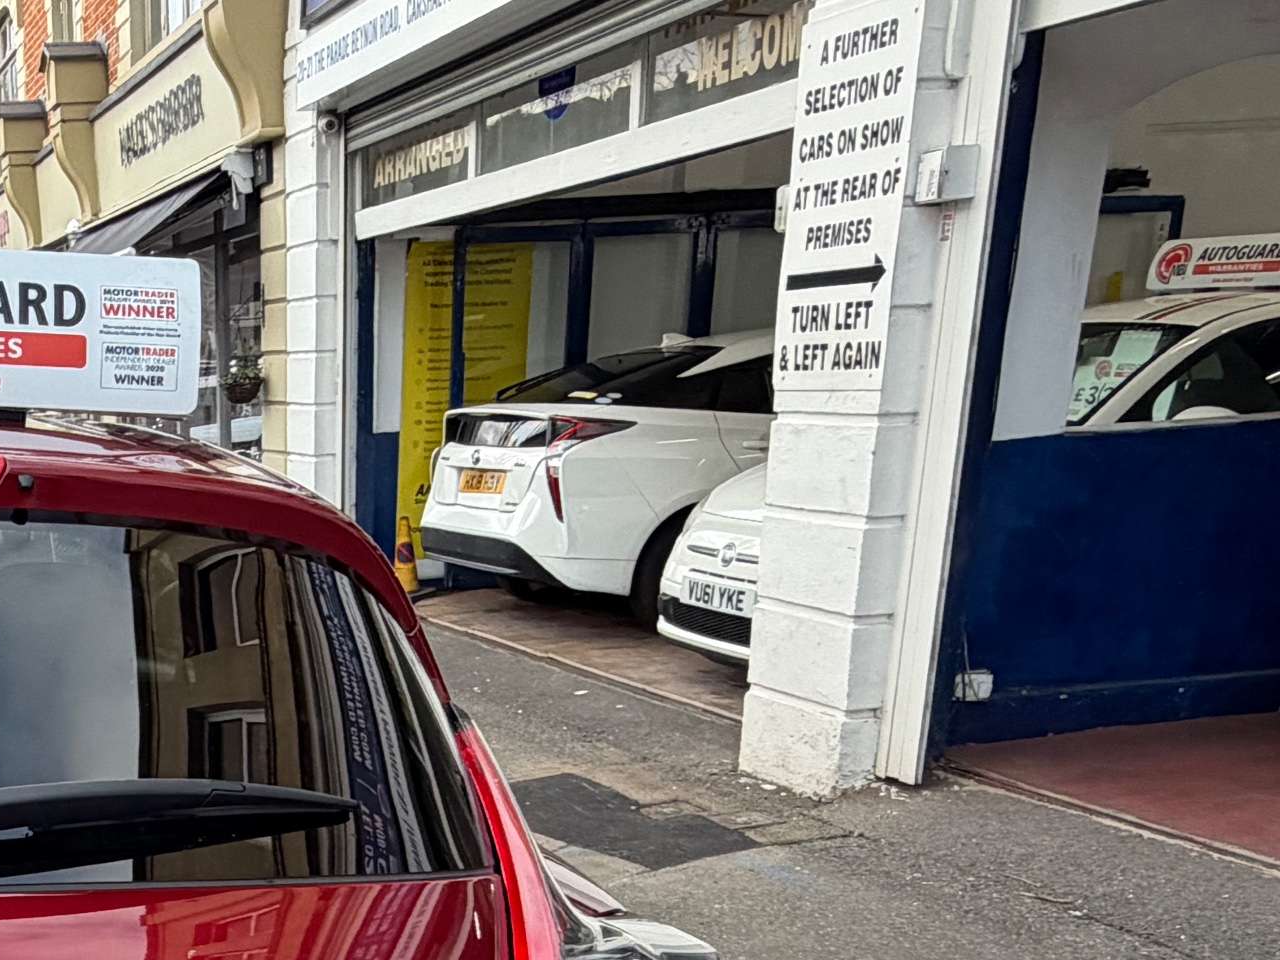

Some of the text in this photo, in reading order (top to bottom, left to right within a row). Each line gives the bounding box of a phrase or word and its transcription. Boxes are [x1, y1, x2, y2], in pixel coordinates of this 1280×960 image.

[697, 9, 804, 92] WELCOM
[820, 18, 899, 66] A FURTHER
[804, 66, 904, 116] SELECTION OF
[799, 115, 904, 163] CARS ON SHOW
[793, 185, 810, 212] AT
[814, 180, 838, 208] THE
[841, 172, 877, 203] REAR
[881, 167, 901, 196] OF
[805, 217, 872, 251] PREMISES
[1197, 243, 1280, 262] AUTOGUAR
[103, 303, 176, 320] WINNER
[792, 300, 873, 333] TURN LEFT
[779, 340, 881, 371] & LEFT AGAIN
[113, 374, 164, 387] WINNER
[718, 587, 746, 612] YKE
